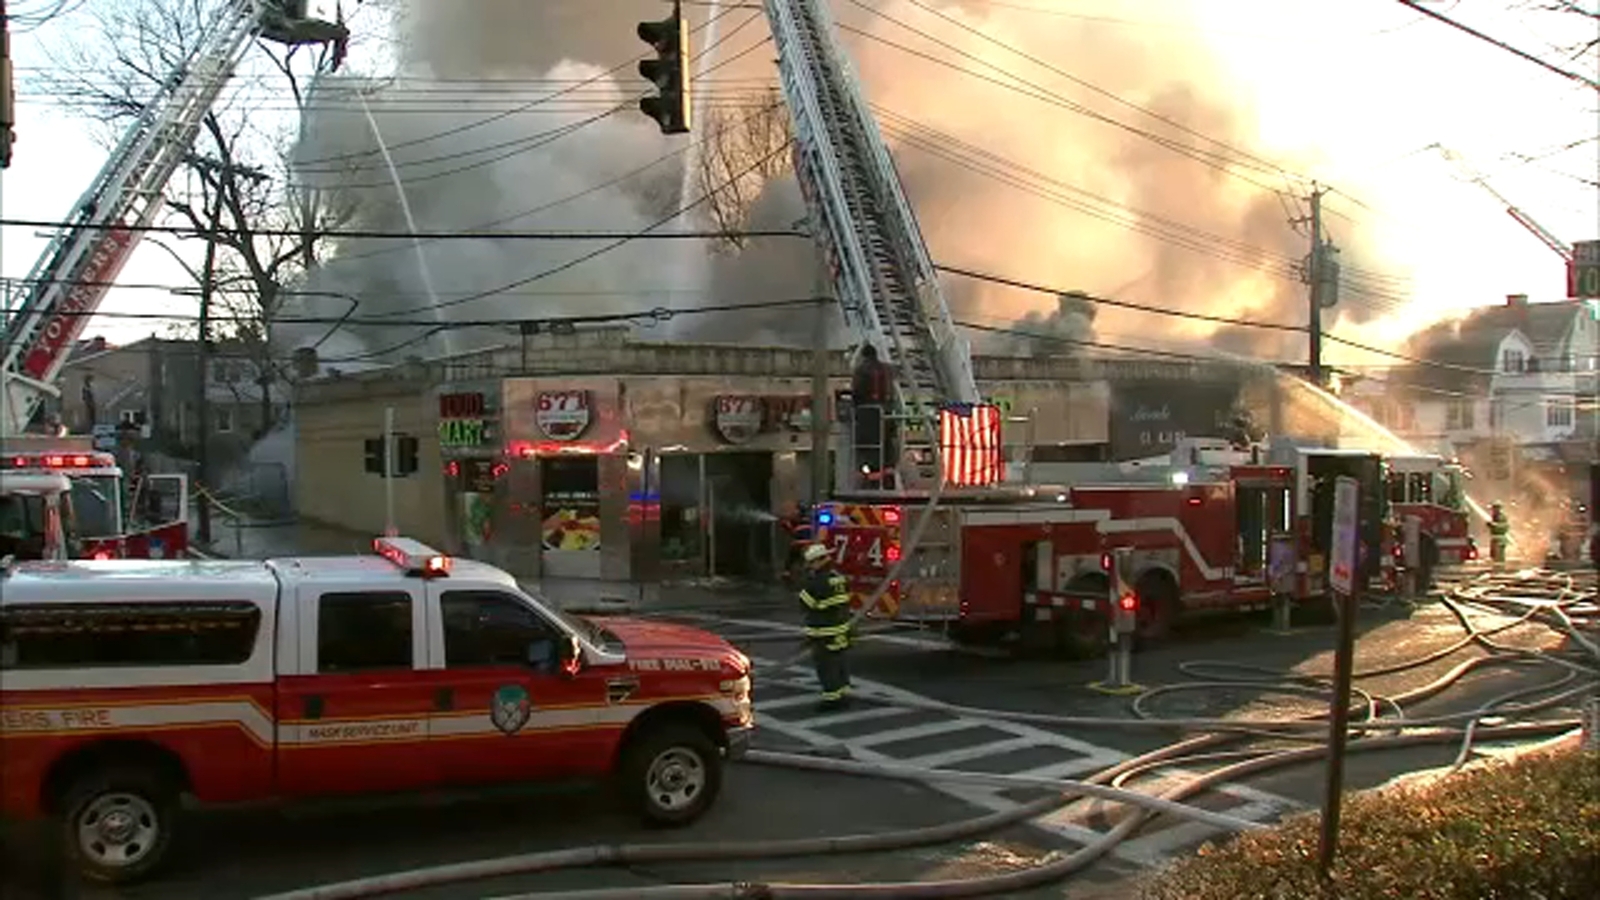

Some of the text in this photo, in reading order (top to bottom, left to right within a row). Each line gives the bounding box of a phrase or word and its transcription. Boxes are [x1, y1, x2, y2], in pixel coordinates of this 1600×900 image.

[867, 537, 883, 567] 4
[2, 708, 111, 729] ERS FIRE
